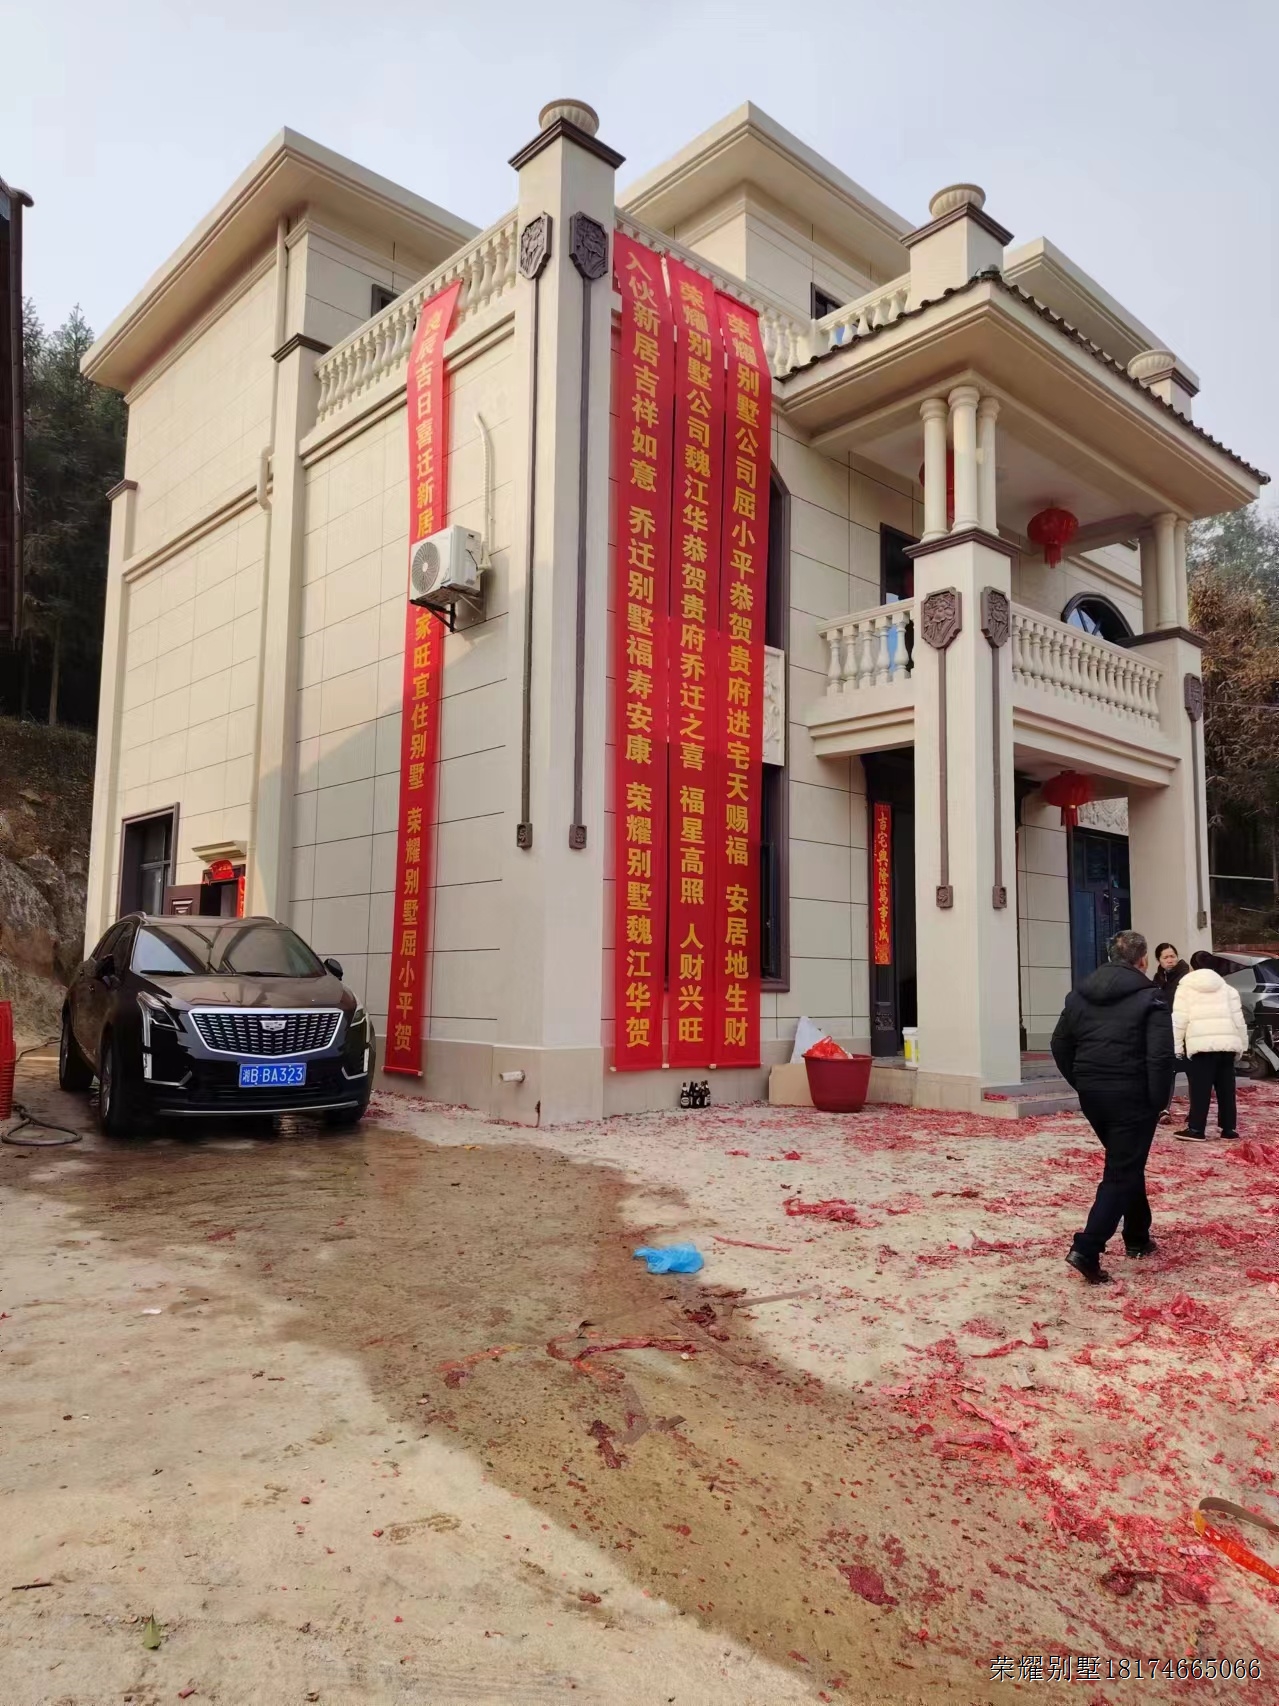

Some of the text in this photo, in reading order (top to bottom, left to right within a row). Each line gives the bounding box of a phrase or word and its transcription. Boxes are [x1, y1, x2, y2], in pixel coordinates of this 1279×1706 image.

[625, 252, 661, 1047] 入伙新居吉祥如意 乔迁别墅福寿安康 荣耀别墅魏江华贺
[680, 785, 705, 905] 福星高照
[393, 806, 422, 1052] 荣耀别墅屈小平贺
[679, 923, 704, 1043] 人财兴旺
[724, 884, 749, 1046] 安居地生财
